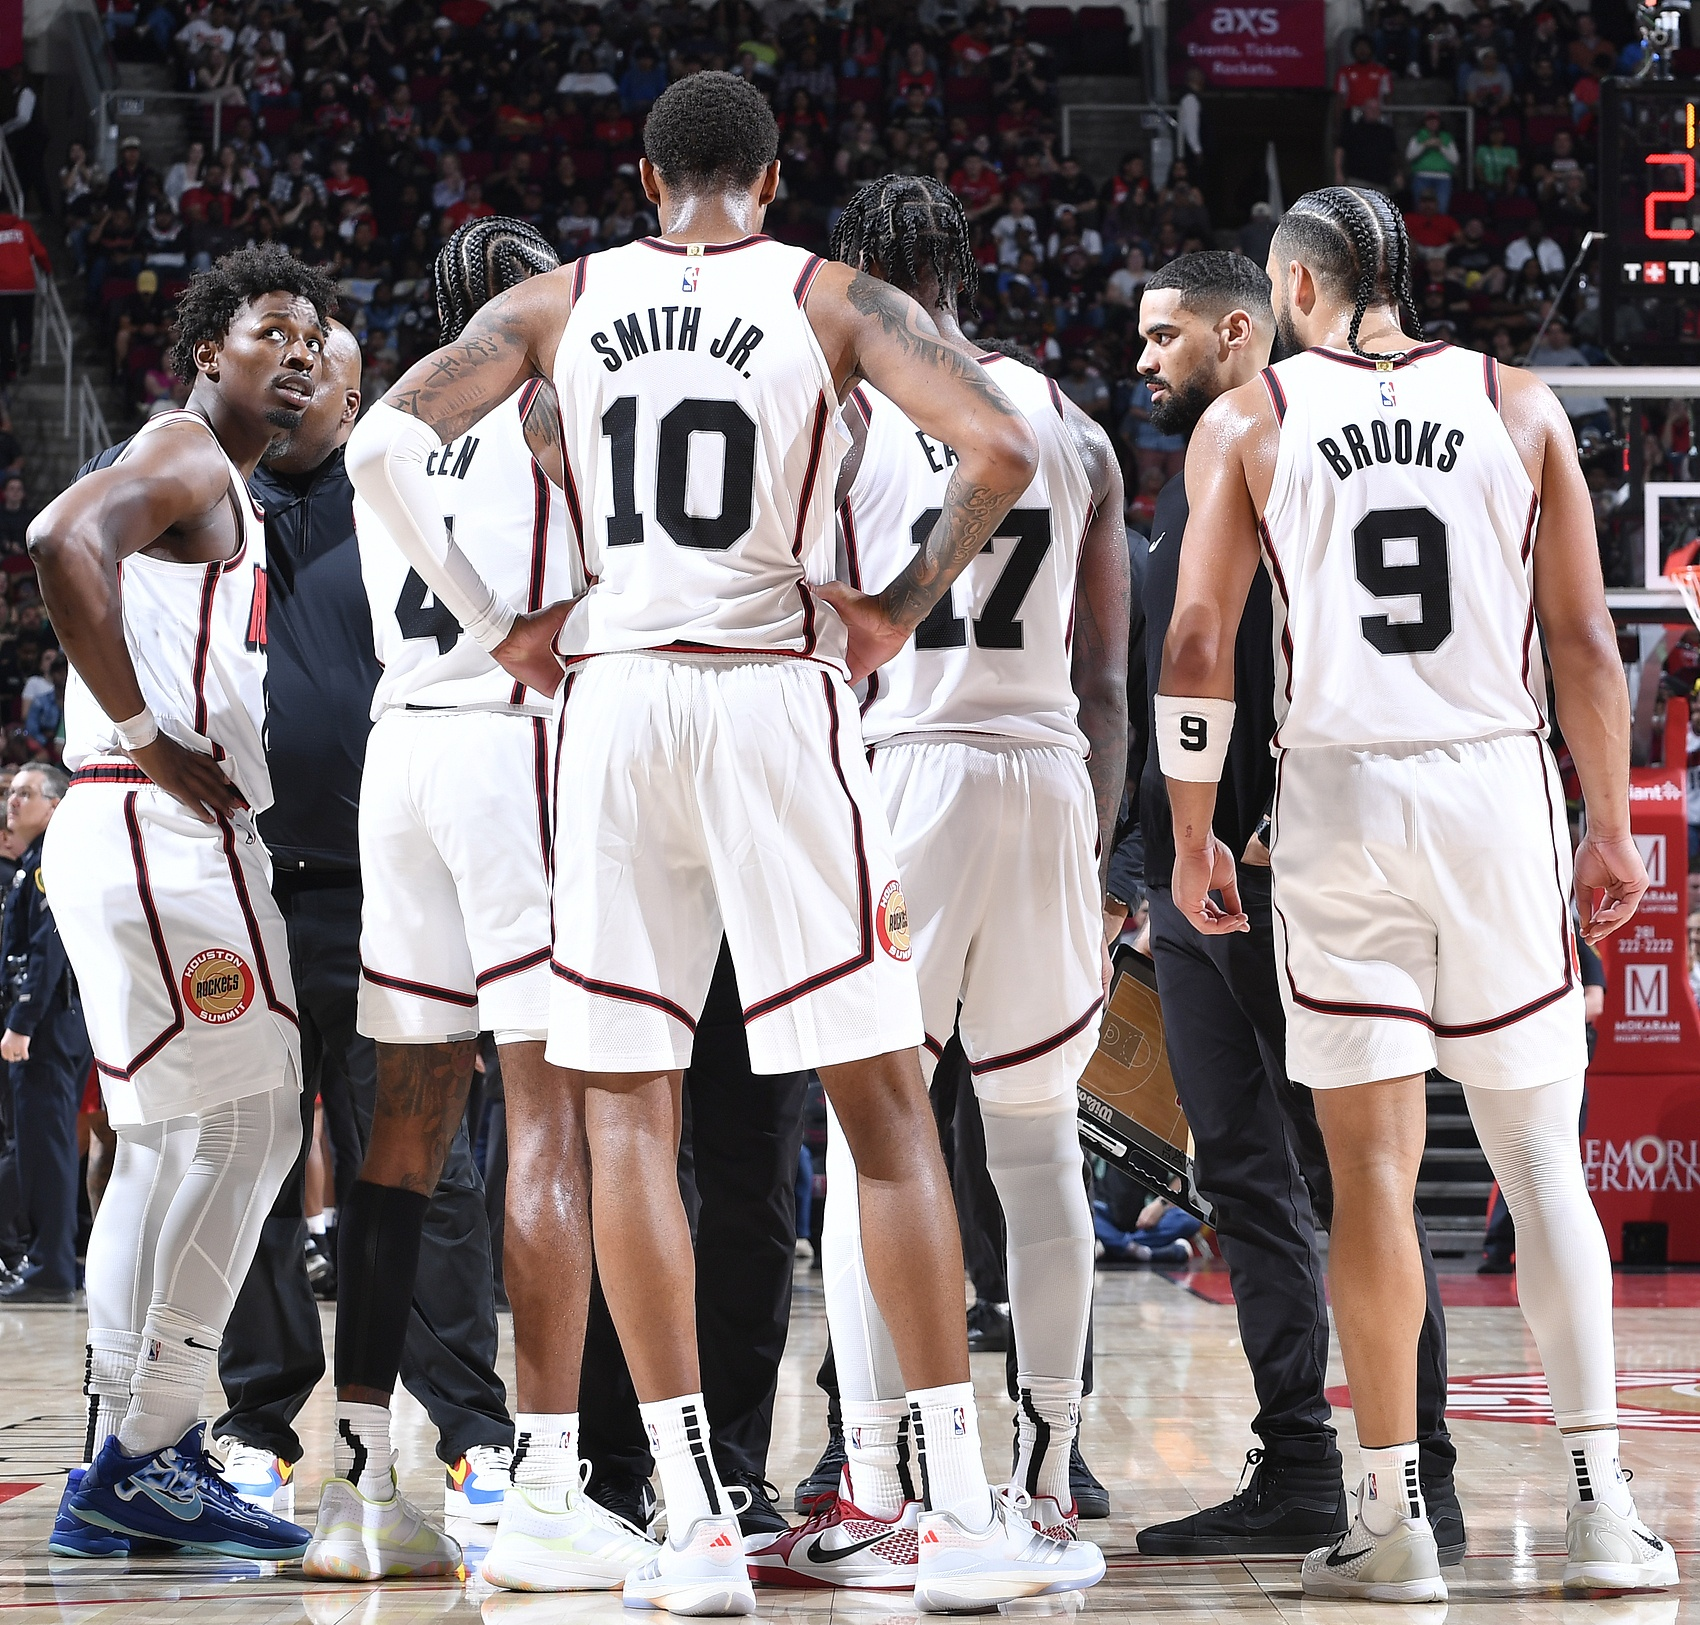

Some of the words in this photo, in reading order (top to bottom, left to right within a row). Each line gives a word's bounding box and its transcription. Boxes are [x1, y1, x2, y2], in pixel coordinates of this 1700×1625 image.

[1211, 7, 1280, 38] axs
[1645, 154, 1695, 240] 2
[590, 306, 701, 372] SMITH
[709, 316, 764, 380] JR.
[600, 394, 759, 552] 10
[1317, 418, 1464, 481] BROOKS
[910, 507, 1053, 652] 17
[1351, 506, 1454, 656] 9
[1180, 714, 1208, 752] 9
[184, 951, 244, 978] HOUSTON
[1631, 969, 1662, 1012] M
[199, 1001, 246, 1022] SUMMIT
